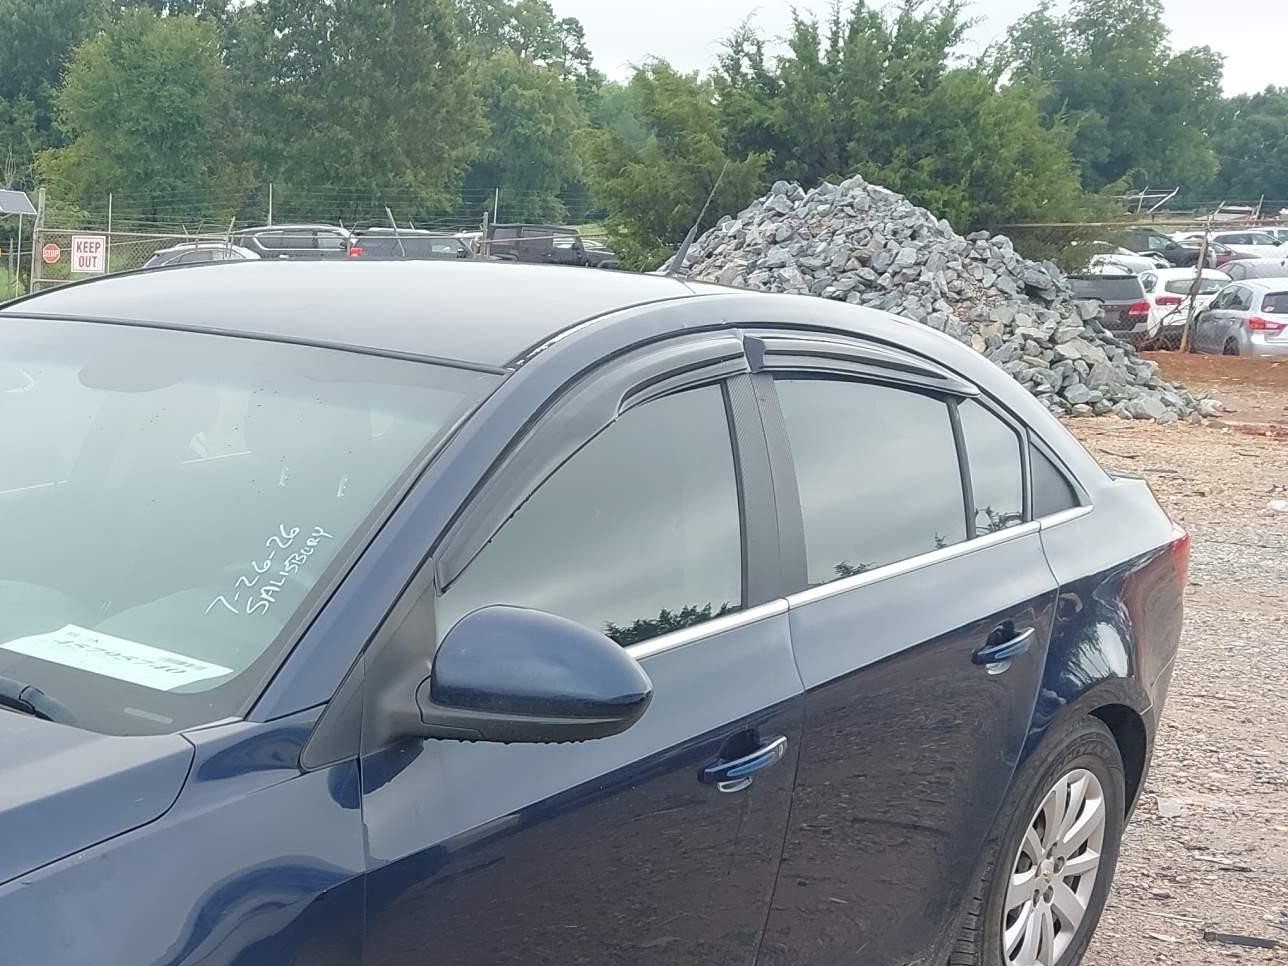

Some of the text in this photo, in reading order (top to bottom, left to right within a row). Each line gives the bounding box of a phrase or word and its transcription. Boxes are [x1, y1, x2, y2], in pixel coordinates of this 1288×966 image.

[44, 249, 59, 257] STOP
[76, 241, 101, 253] KEEP
[78, 256, 98, 268] OUT
[202, 524, 300, 615] 7-26-26
[246, 526, 333, 615] SALISBURY
